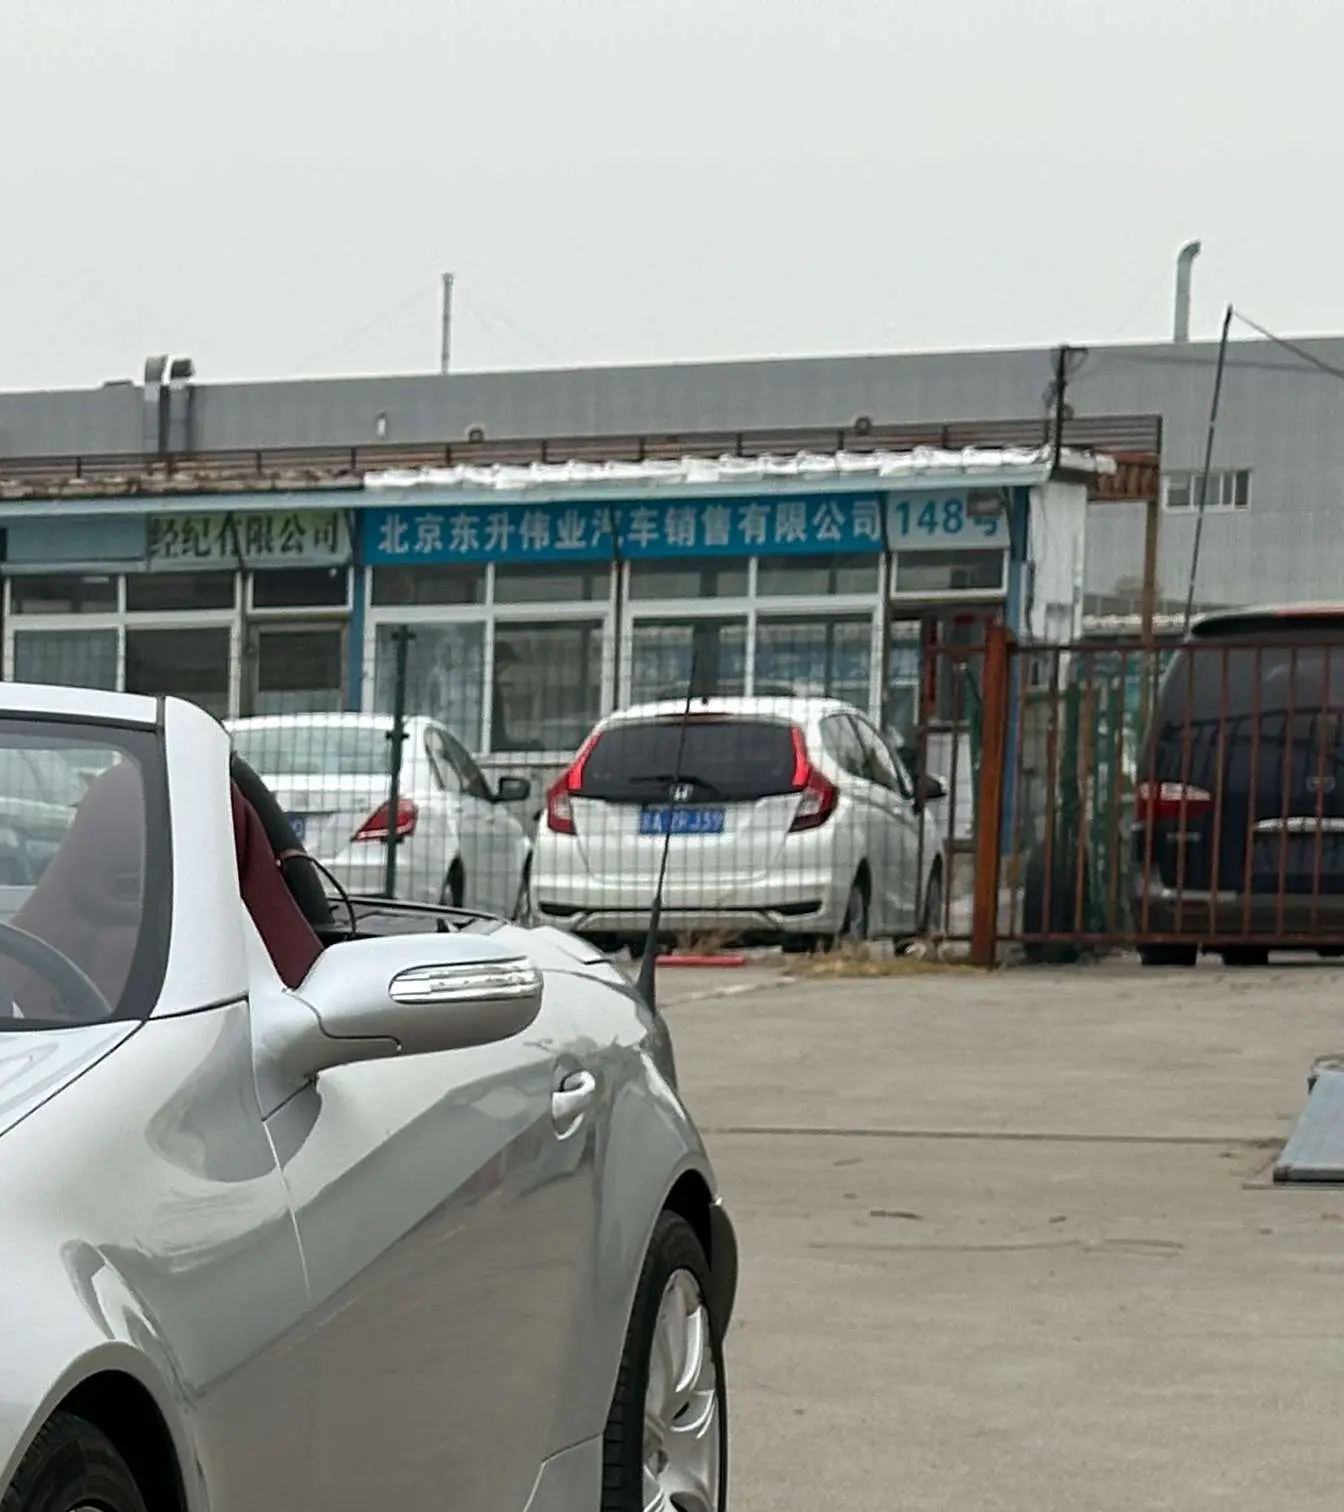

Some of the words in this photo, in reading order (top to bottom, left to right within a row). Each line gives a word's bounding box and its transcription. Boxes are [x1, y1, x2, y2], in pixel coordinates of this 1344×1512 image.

[378, 500, 880, 555] 北京东升伟业汽车销售有限公司
